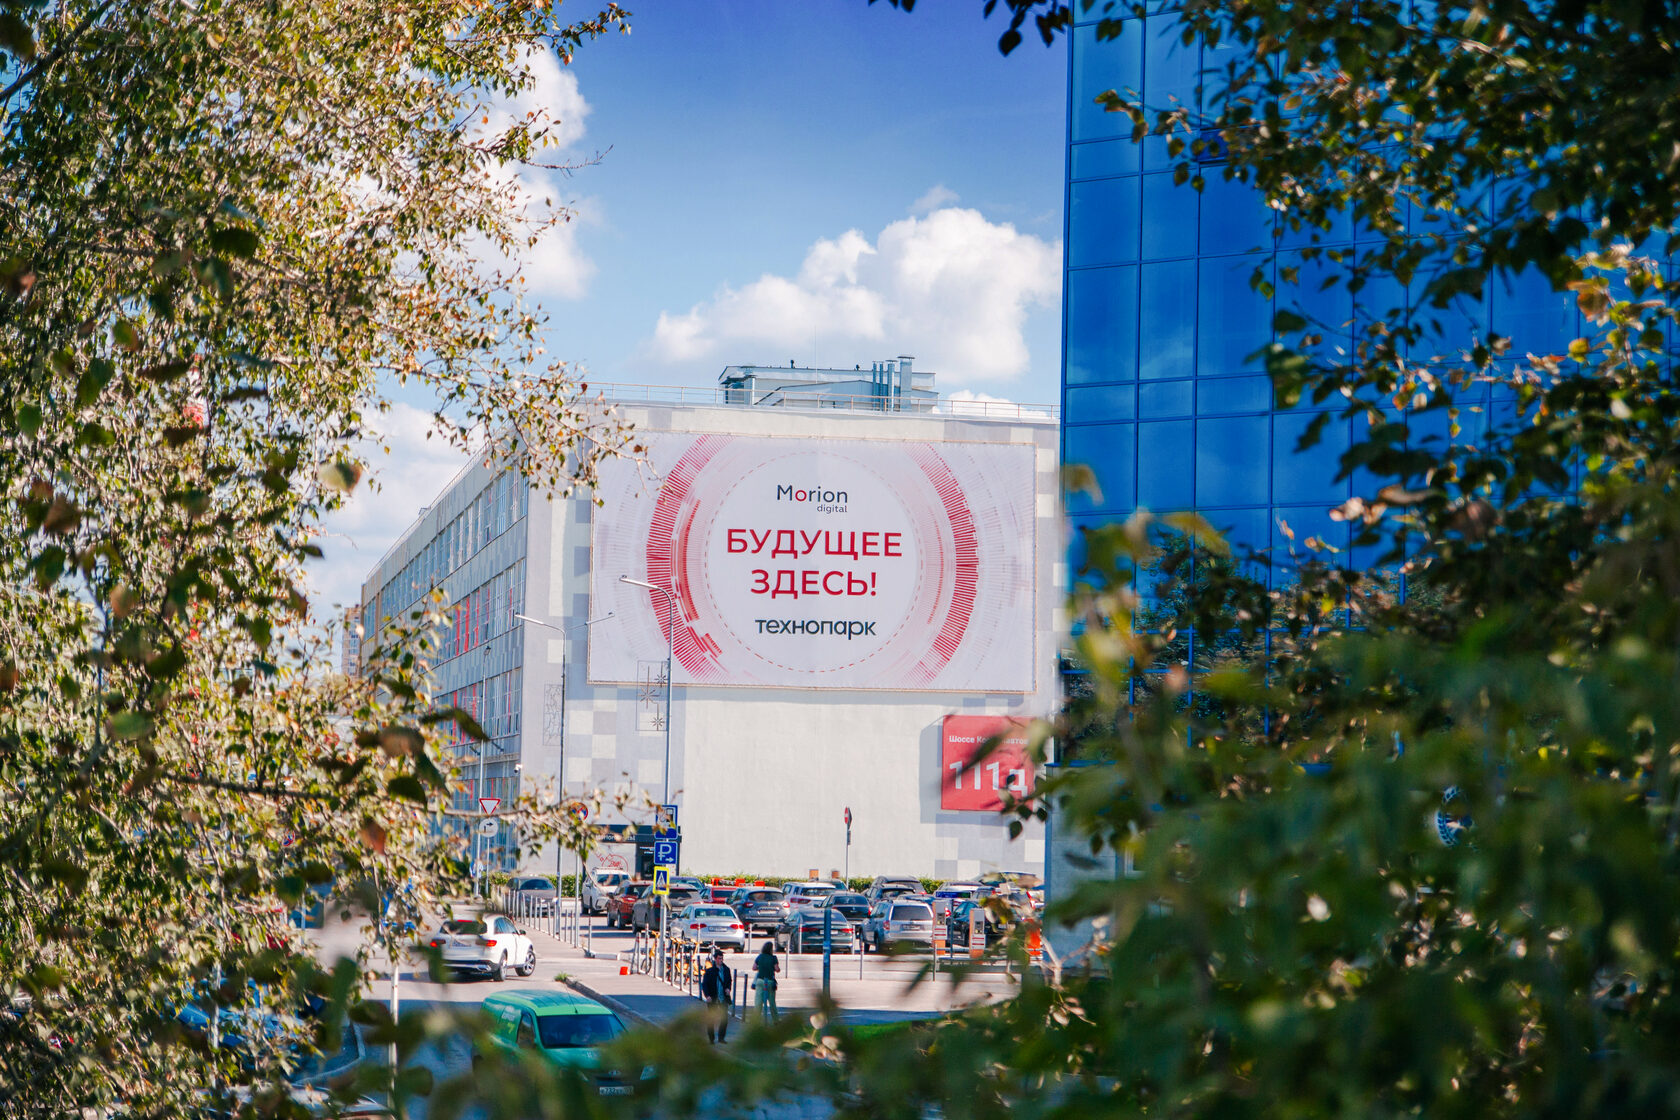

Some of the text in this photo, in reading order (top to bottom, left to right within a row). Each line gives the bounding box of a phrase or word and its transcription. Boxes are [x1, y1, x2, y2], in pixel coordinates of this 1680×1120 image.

[777, 484, 848, 503] Morion
[816, 504, 848, 514] digital
[727, 528, 903, 561] БУДУЩЕЕ
[750, 568, 877, 600] ЗДЕСЬ!
[755, 619, 877, 641] технопарк
[948, 735, 975, 744] Шоссе
